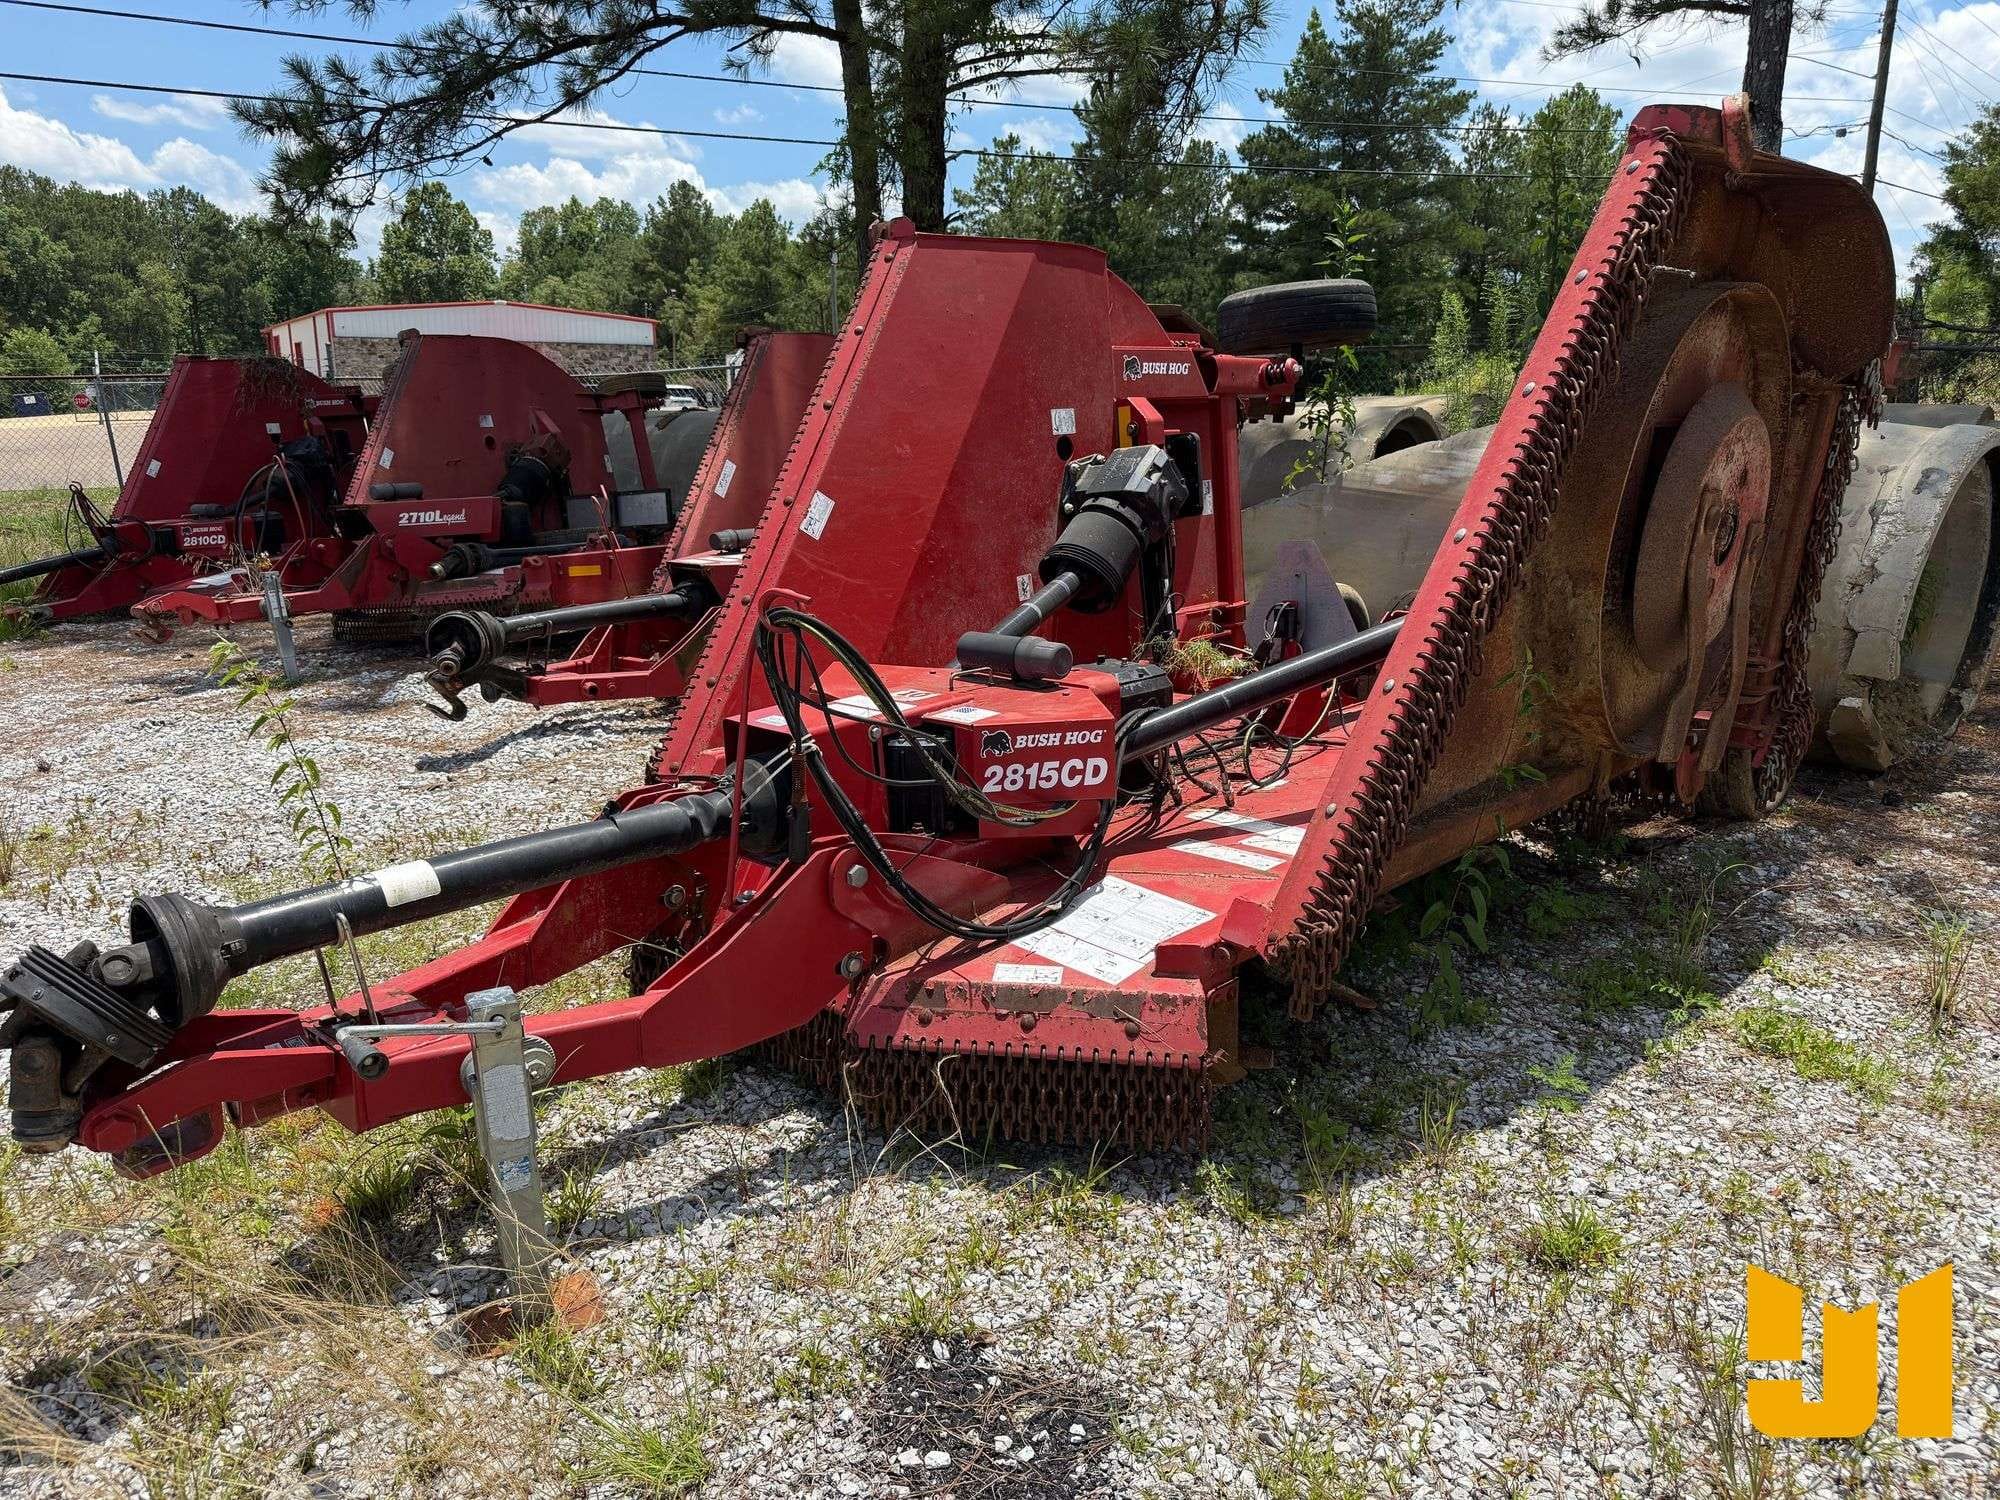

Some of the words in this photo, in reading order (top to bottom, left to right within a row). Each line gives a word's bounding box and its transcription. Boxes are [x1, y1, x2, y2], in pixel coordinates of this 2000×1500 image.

[1142, 362, 1167, 375] BUSH
[1168, 362, 1189, 375] HOG
[74, 396, 89, 405] STOP
[183, 534, 226, 547] 2810CD
[1014, 733, 1062, 749] BUSH
[1063, 729, 1103, 746] HOG
[981, 757, 1108, 793] 2815CD
